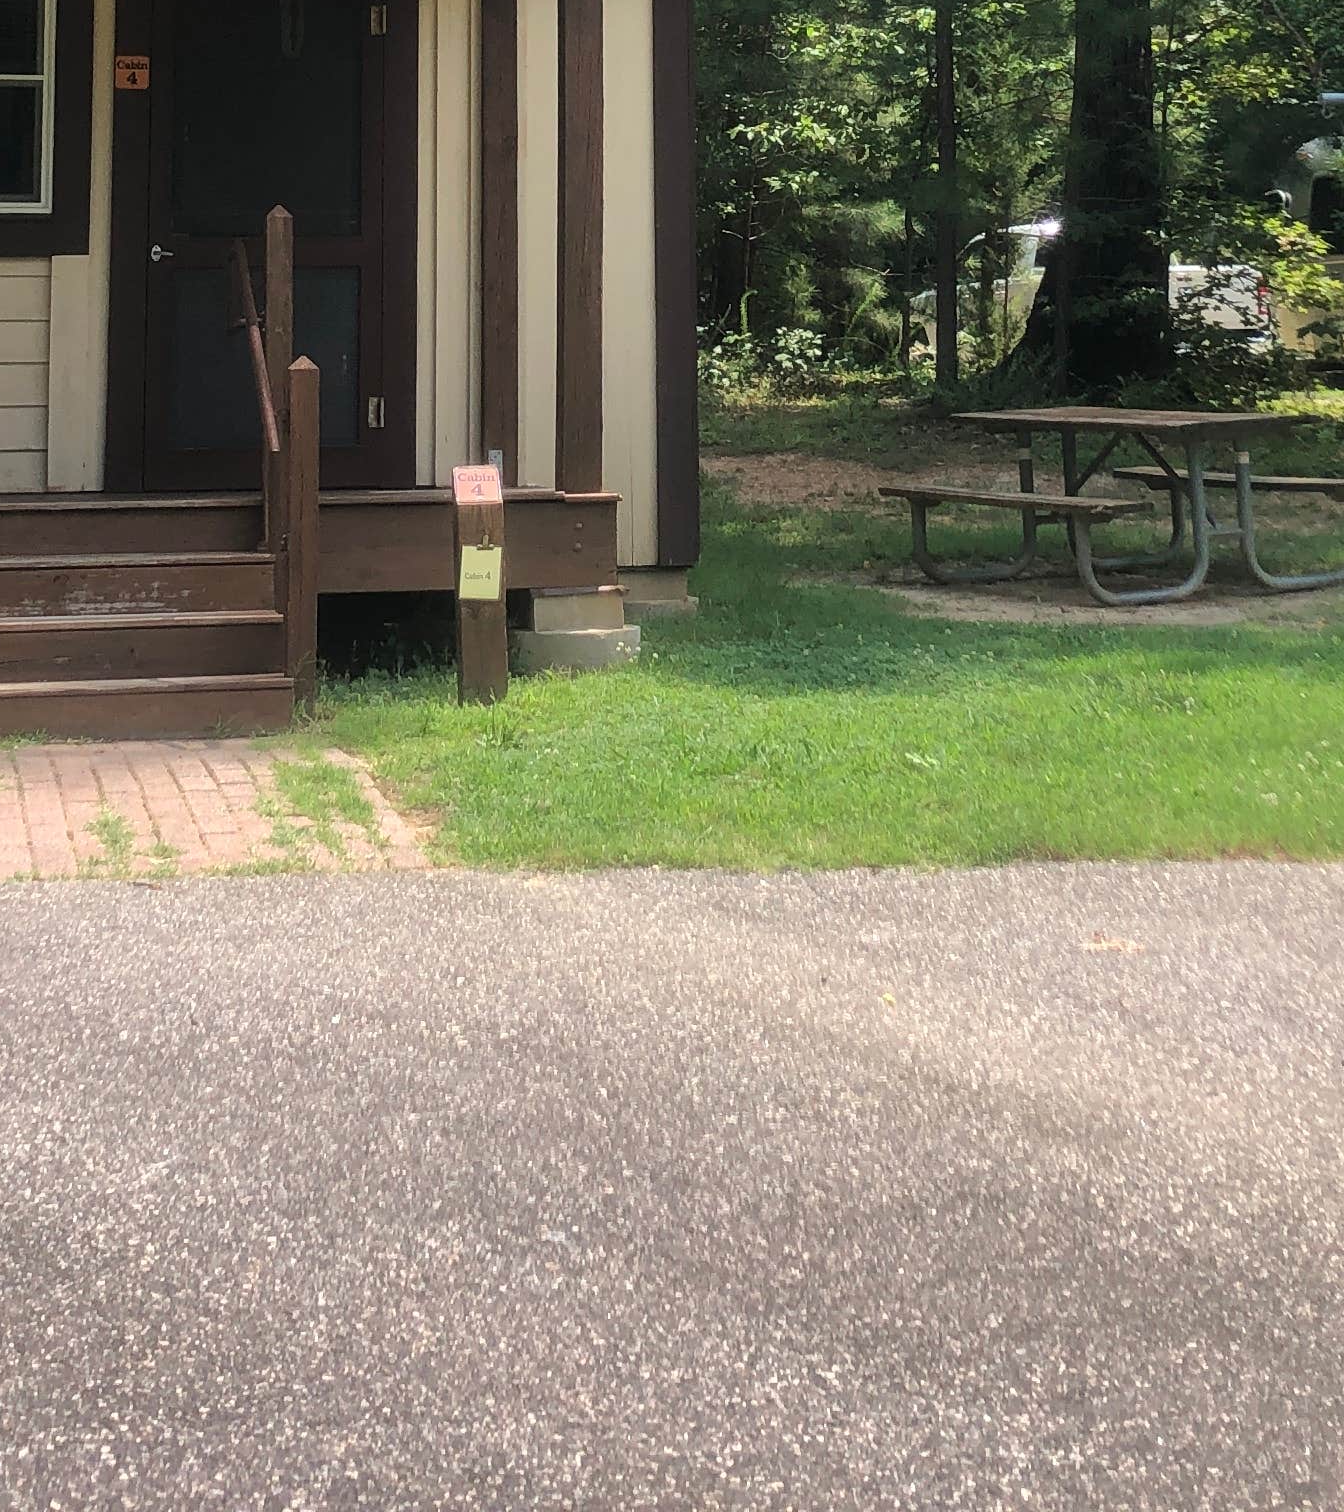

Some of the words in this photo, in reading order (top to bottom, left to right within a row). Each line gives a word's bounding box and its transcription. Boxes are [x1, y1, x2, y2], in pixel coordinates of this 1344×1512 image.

[116, 59, 148, 70] Cabin
[126, 71, 138, 85] 4
[457, 472, 496, 482] Cabin
[470, 484, 485, 497] 4
[464, 571, 484, 580] Cabin
[485, 571, 492, 580] 4
